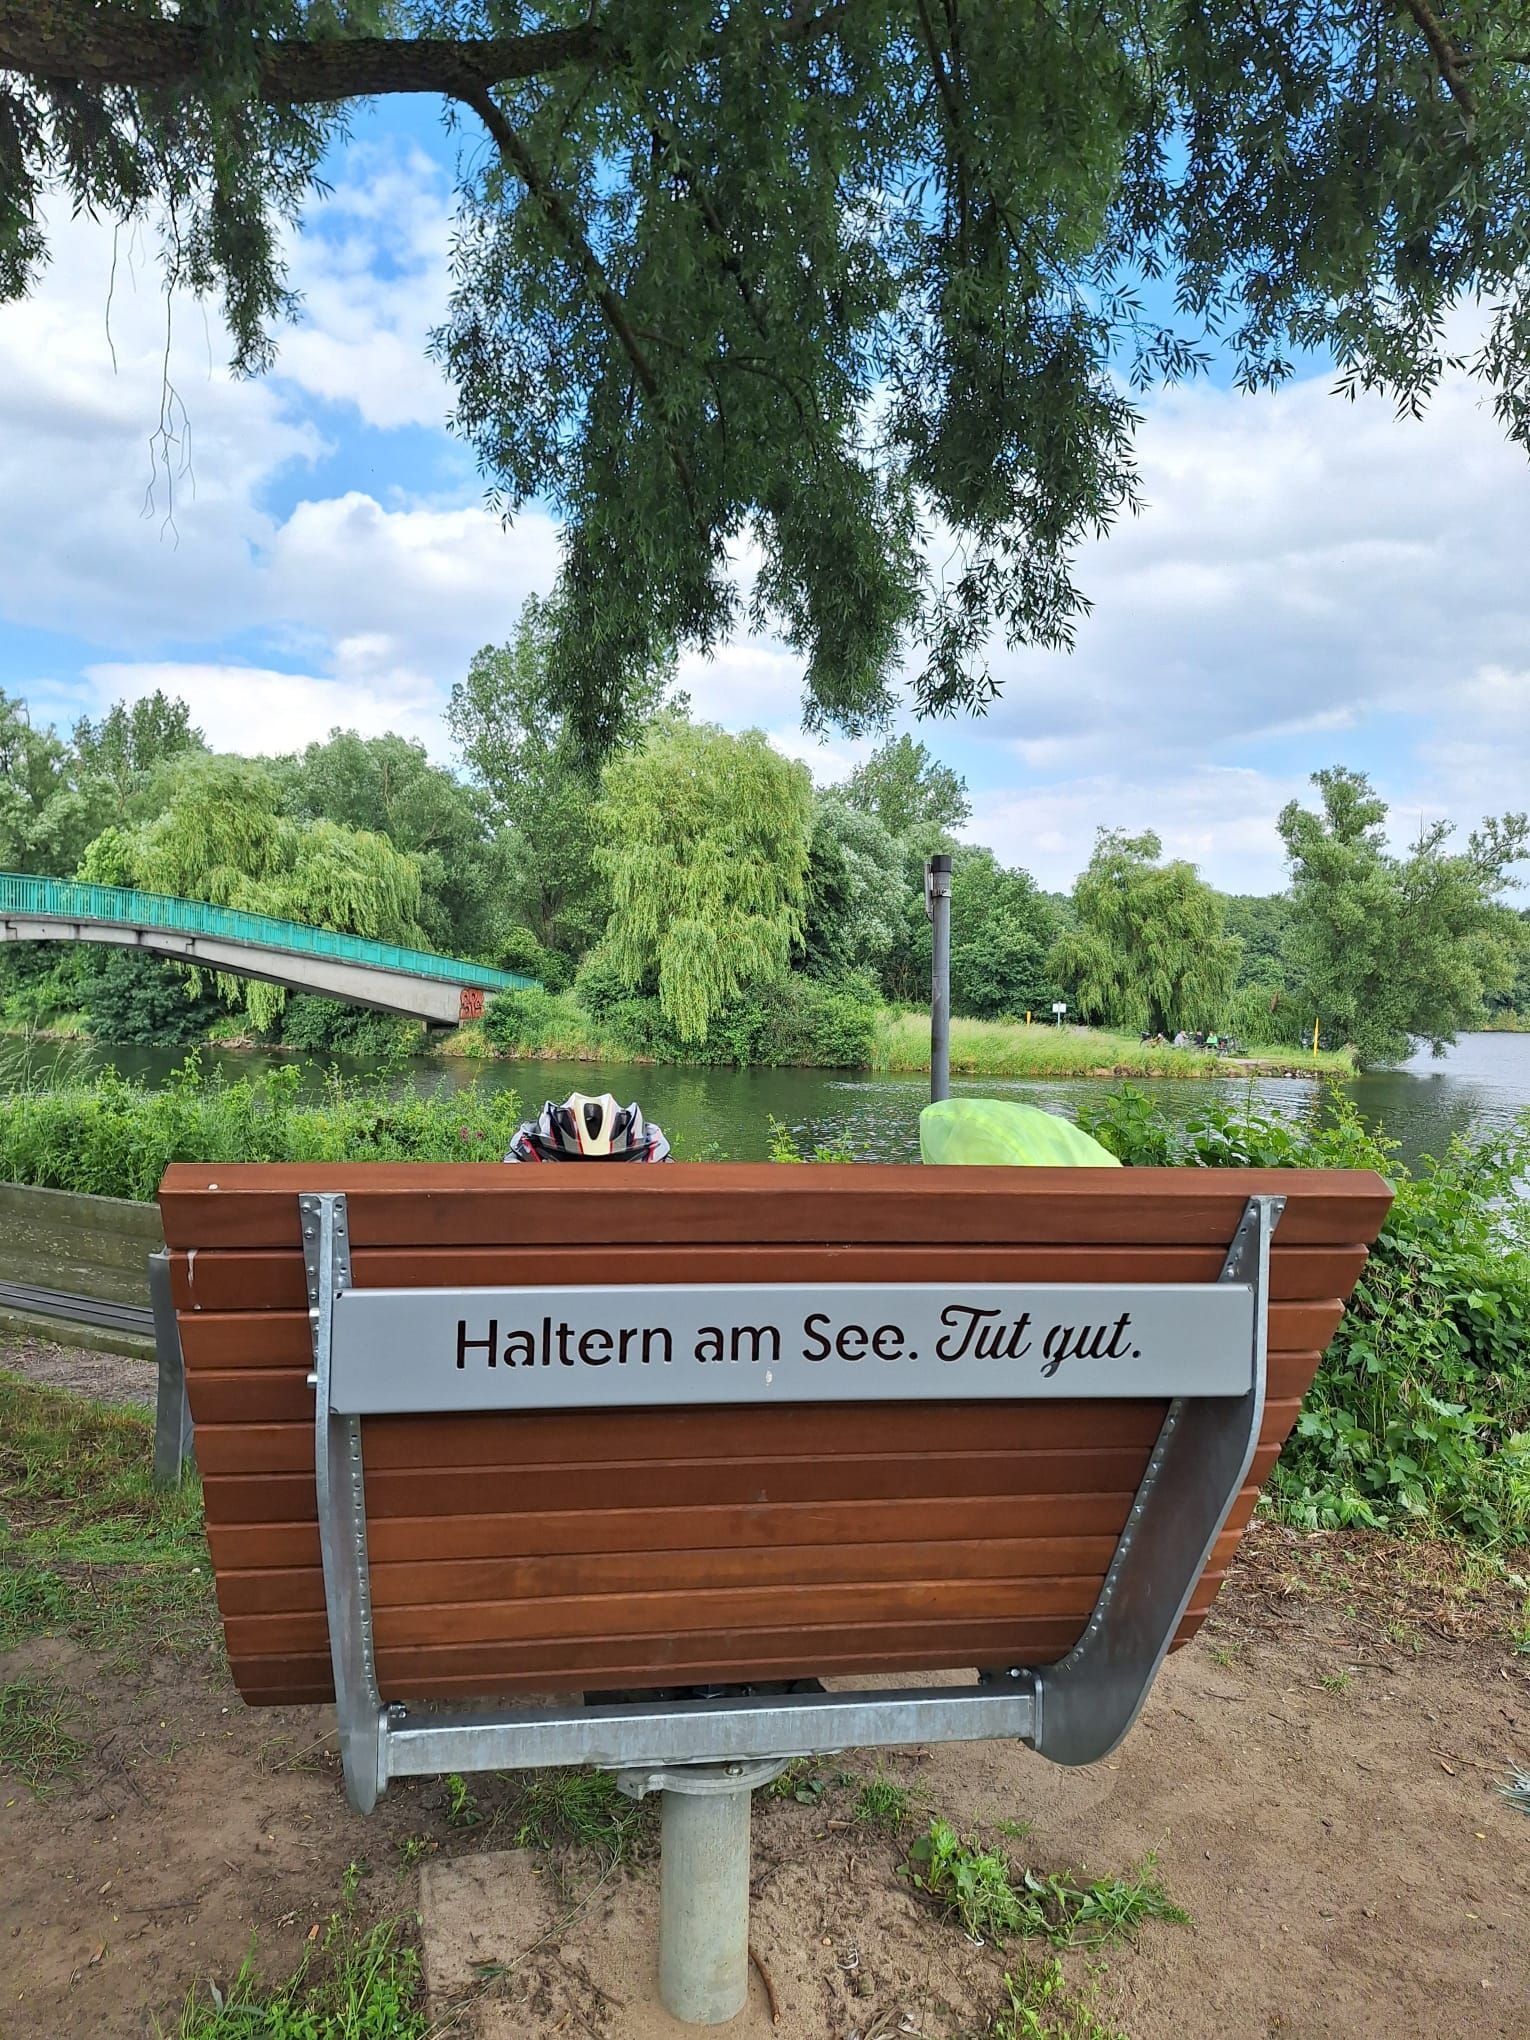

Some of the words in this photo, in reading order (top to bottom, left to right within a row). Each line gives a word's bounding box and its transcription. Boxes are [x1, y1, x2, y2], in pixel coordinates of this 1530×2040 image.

[457, 1316, 673, 1370] Haltern
[694, 1325, 781, 1363] am
[802, 1313, 918, 1362] See.
[935, 1304, 1033, 1362] Tut
[1040, 1312, 1141, 1378] gut.
